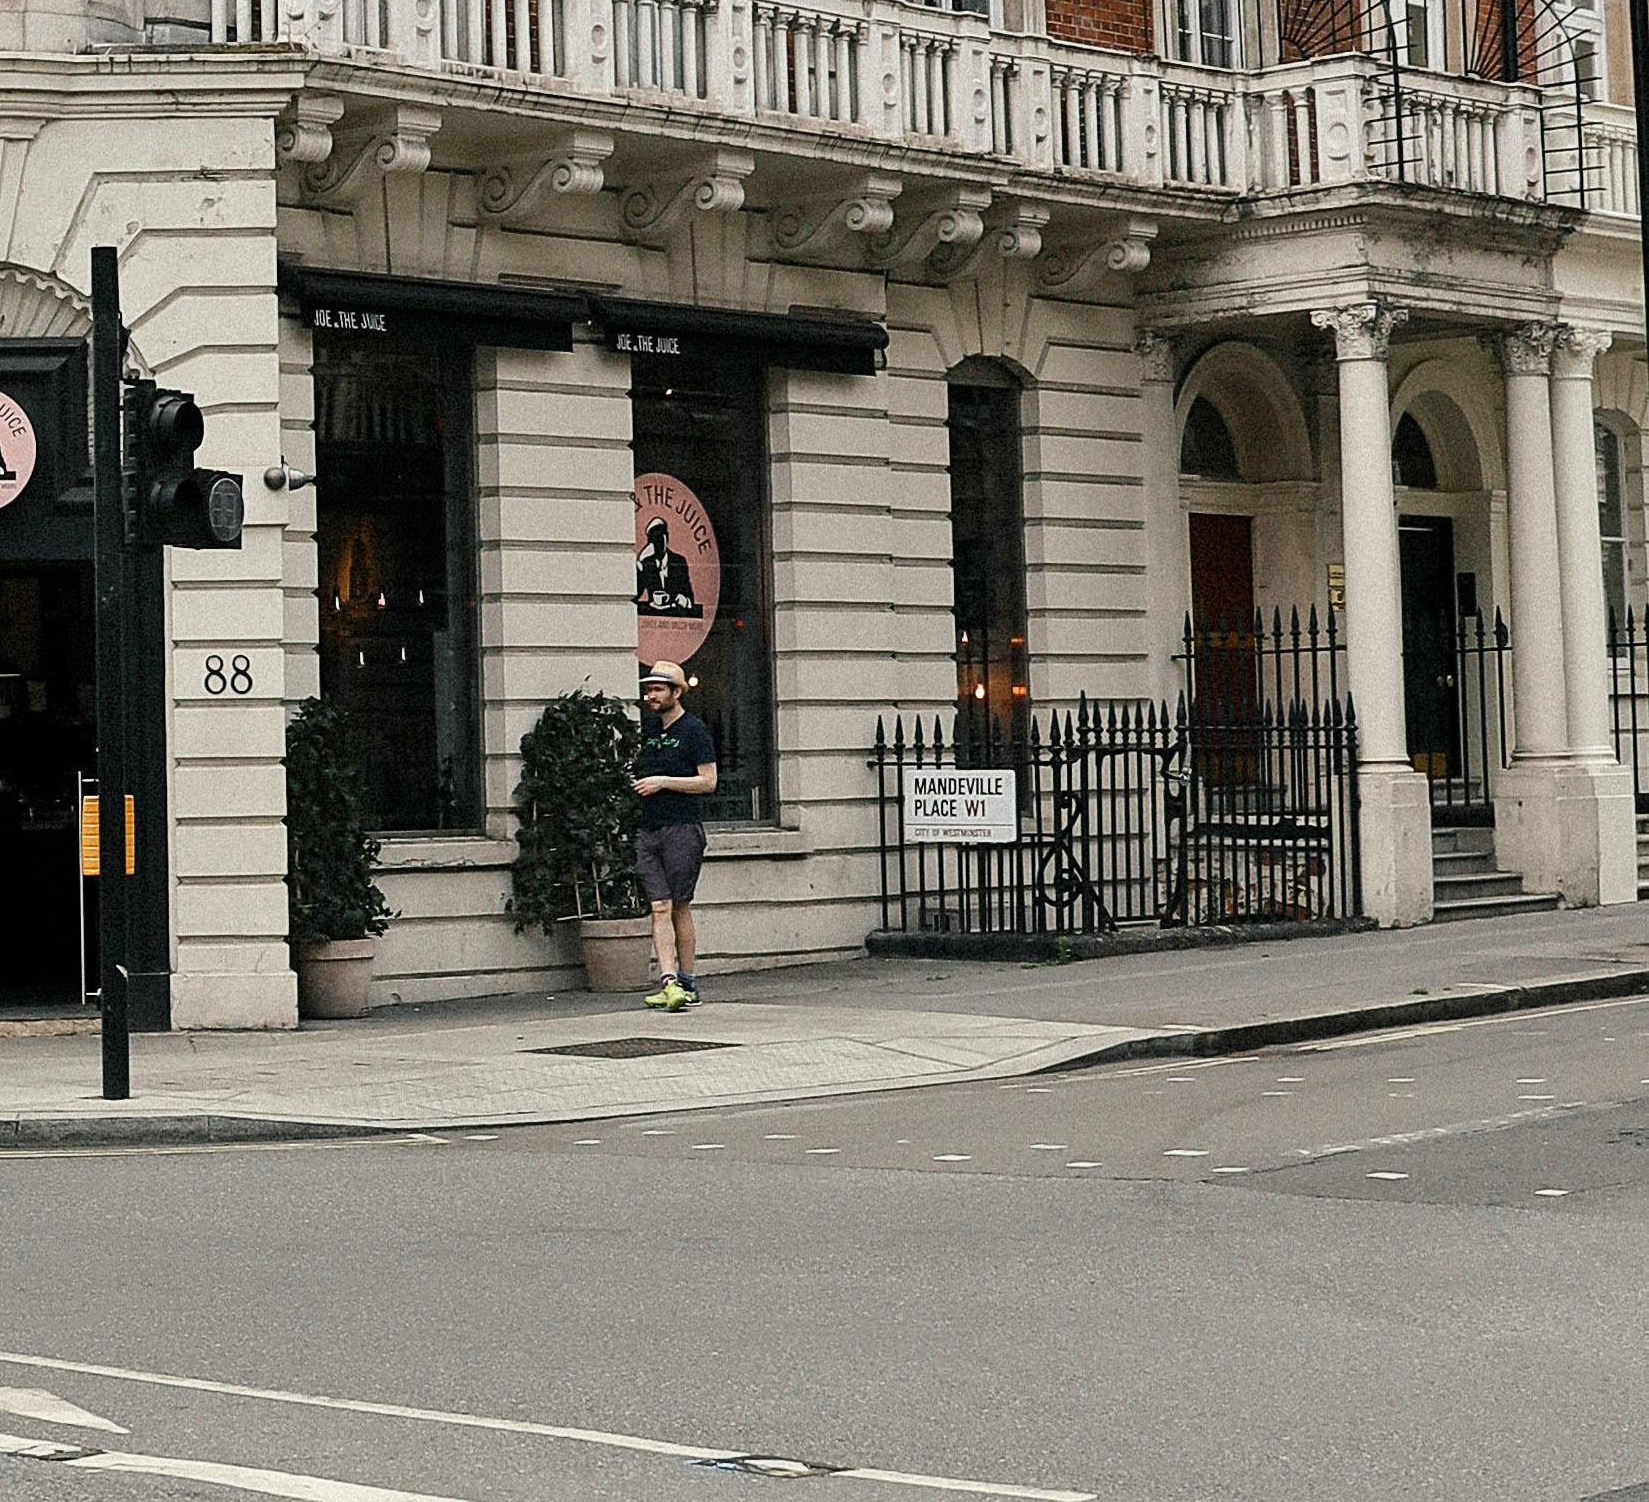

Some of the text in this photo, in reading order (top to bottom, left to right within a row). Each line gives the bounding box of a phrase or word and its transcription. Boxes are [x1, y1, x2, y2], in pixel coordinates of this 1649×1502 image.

[314, 309, 333, 327] JOE
[338, 310, 358, 329] THE
[361, 313, 387, 332] JUICE
[616, 333, 632, 350] JOE
[637, 335, 654, 353] THE
[656, 337, 680, 354] JUICE
[643, 484, 674, 509] THE
[675, 499, 712, 555] JUICE
[204, 654, 253, 695] 88
[914, 777, 1003, 795] MANDEVILLE
[914, 799, 986, 817] PLACE W1
[914, 828, 929, 837] CITY
[942, 828, 992, 838] WESTMINSTER
